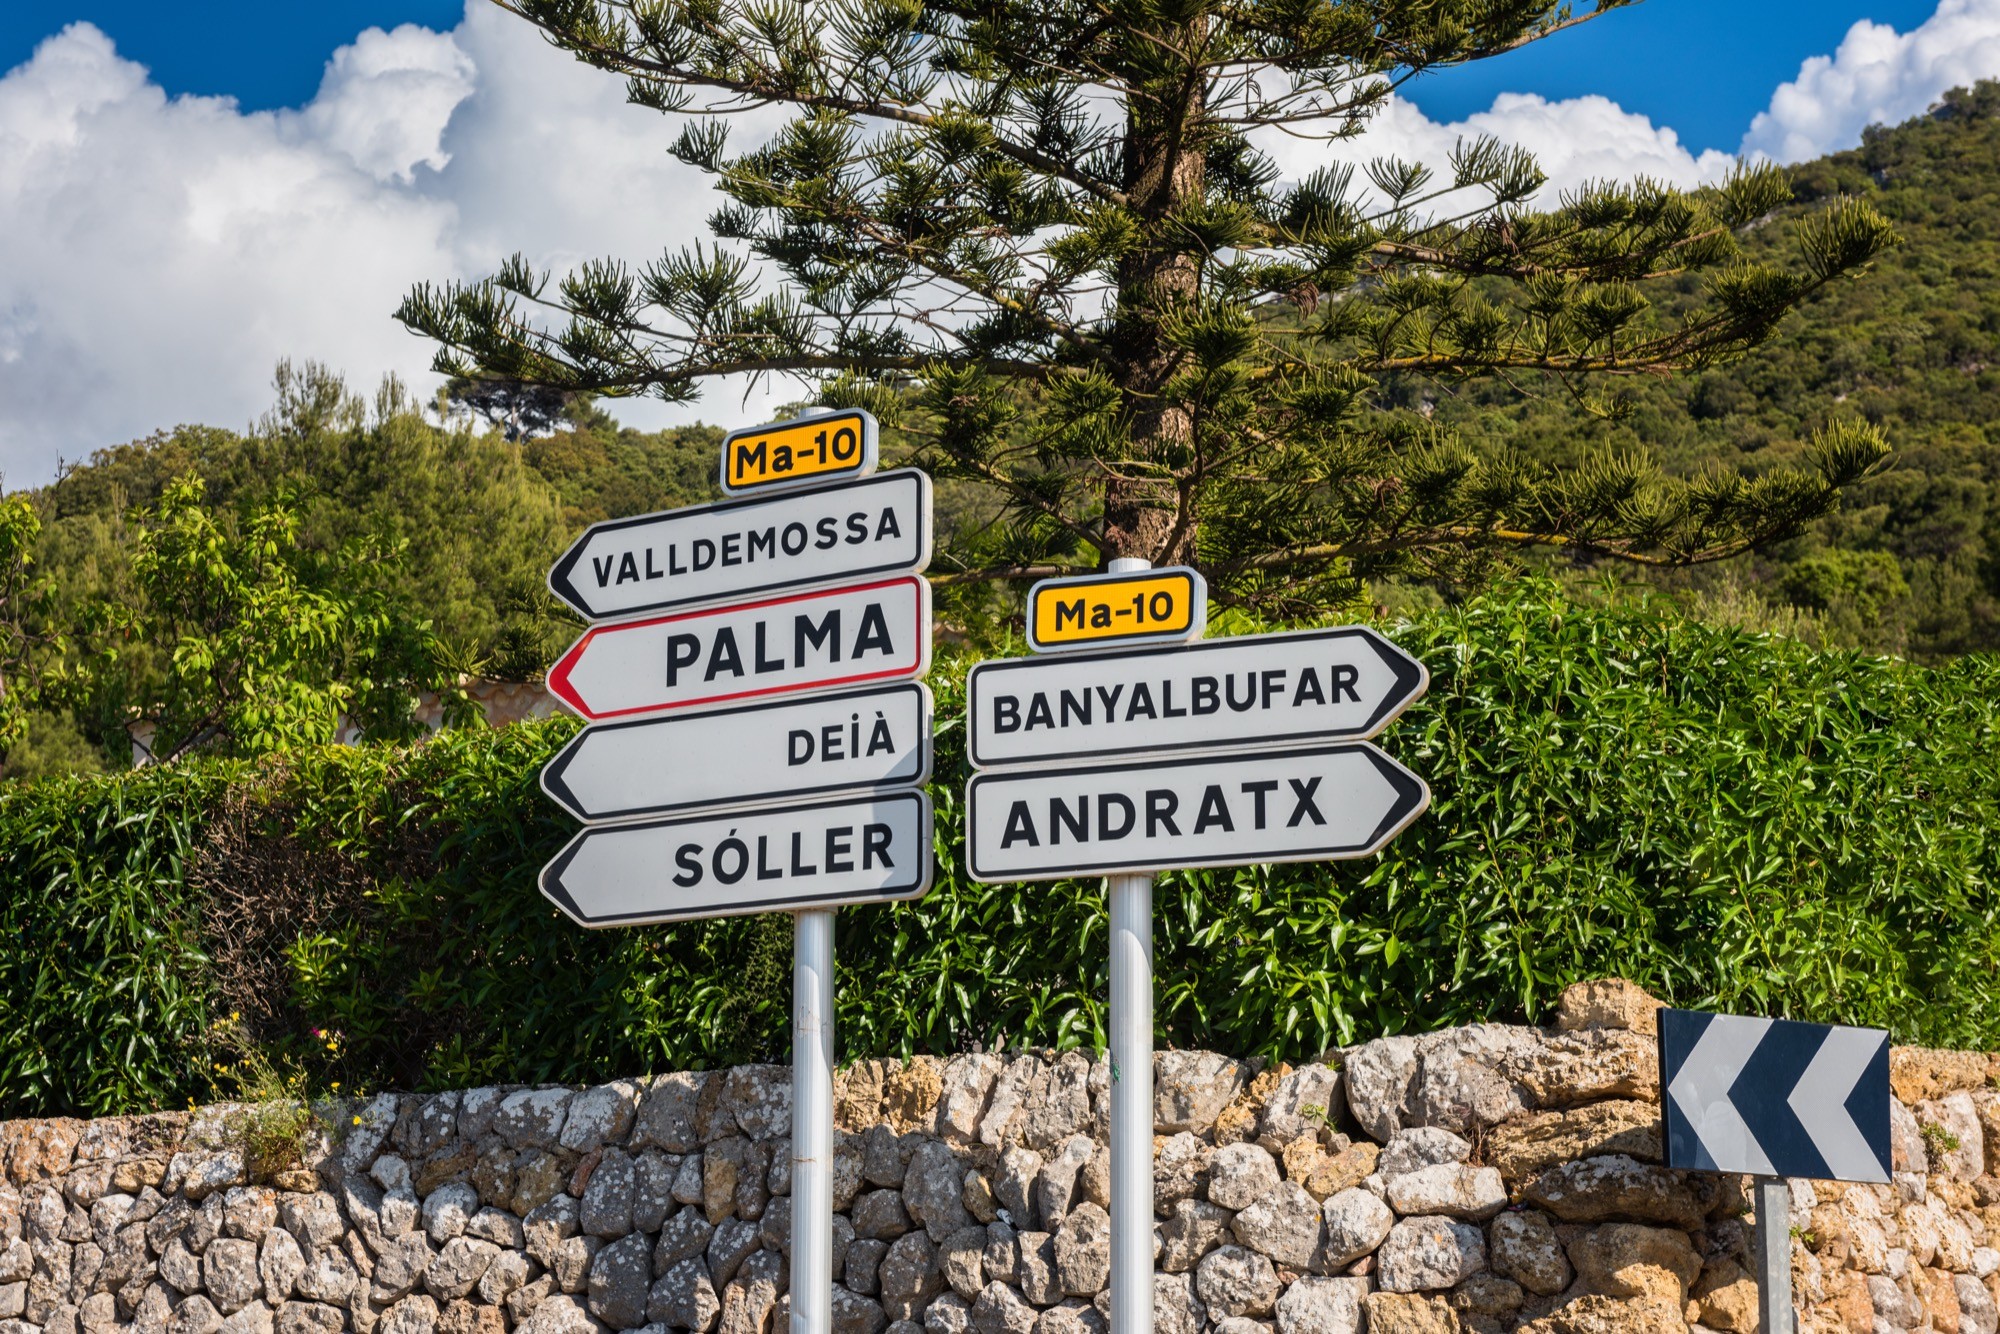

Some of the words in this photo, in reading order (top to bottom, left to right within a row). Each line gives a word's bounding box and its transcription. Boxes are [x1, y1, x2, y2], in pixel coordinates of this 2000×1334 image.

[735, 427, 858, 480] Ma-10
[592, 506, 902, 589] VALLDEMOSSA
[665, 602, 896, 688] PALMA
[1055, 591, 1175, 632] Ma-10
[993, 664, 1362, 735] BANYALBUFAR
[1000, 776, 1328, 850] ANDRATX
[671, 822, 895, 888] SÓLLER
